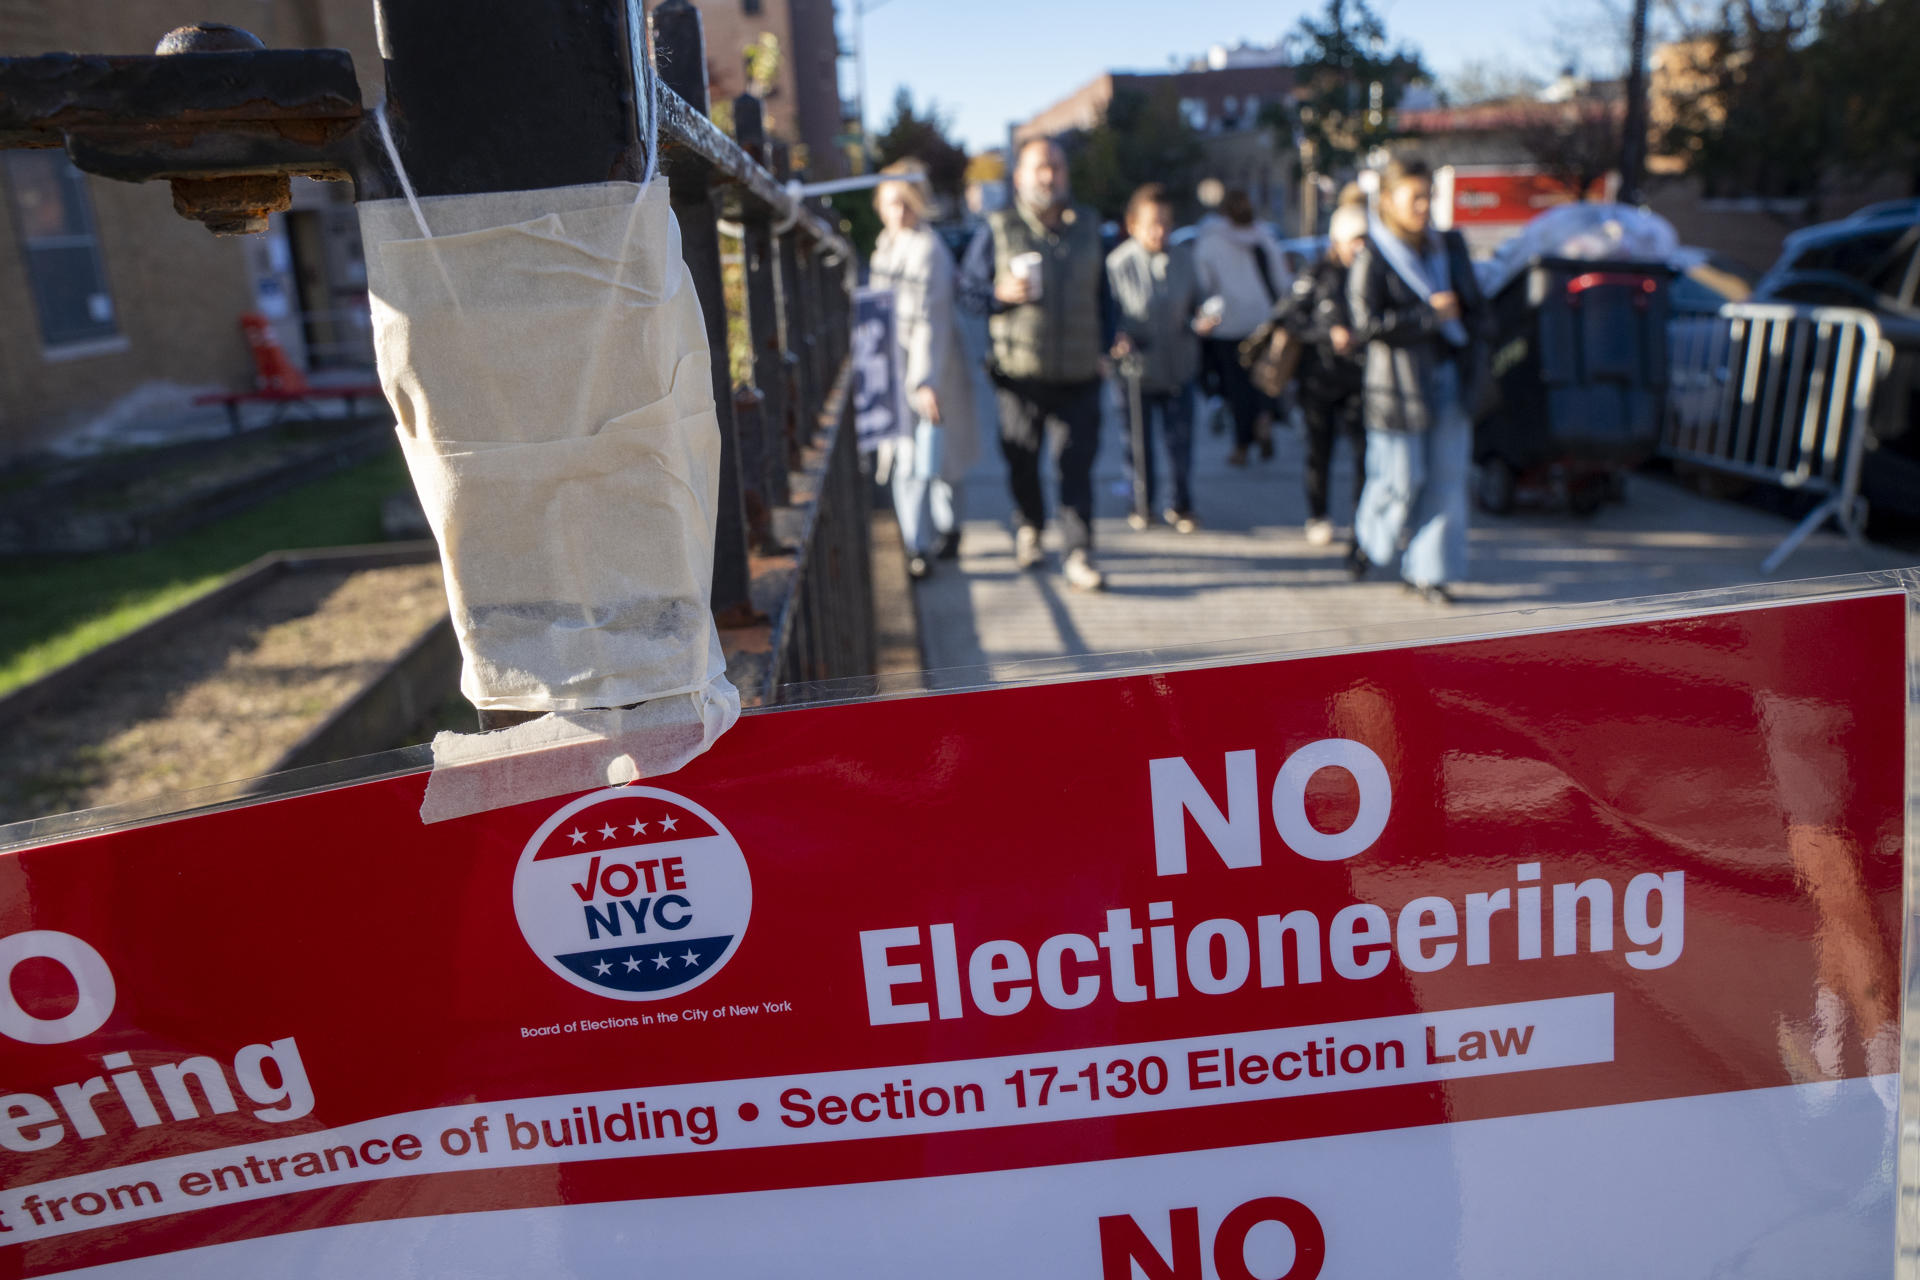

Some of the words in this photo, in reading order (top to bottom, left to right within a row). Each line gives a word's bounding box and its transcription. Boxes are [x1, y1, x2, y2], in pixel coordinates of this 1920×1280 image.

[1149, 738, 1392, 876] NO
[571, 856, 687, 901] VOTE
[584, 894, 693, 940] NYC
[860, 862, 1684, 1026] Electioneering
[520, 1023, 561, 1038] Board
[564, 1020, 577, 1033] of
[580, 1016, 639, 1032] Elections
[642, 1014, 654, 1025] in
[657, 1011, 679, 1024] the
[682, 1009, 709, 1022] City
[713, 1005, 727, 1018] of
[730, 1003, 759, 1017] New
[762, 1000, 792, 1014] York
[0, 1037, 314, 1151] ering
[21, 1180, 163, 1225] from
[178, 1133, 423, 1197] entrance
[440, 1115, 489, 1156] of
[505, 1101, 719, 1151] building
[779, 1079, 985, 1129] Section
[1004, 1056, 1169, 1109] 17-130
[1187, 1034, 1405, 1091] Election
[1426, 1026, 1535, 1066] Law
[1099, 1196, 1325, 1280] NO
